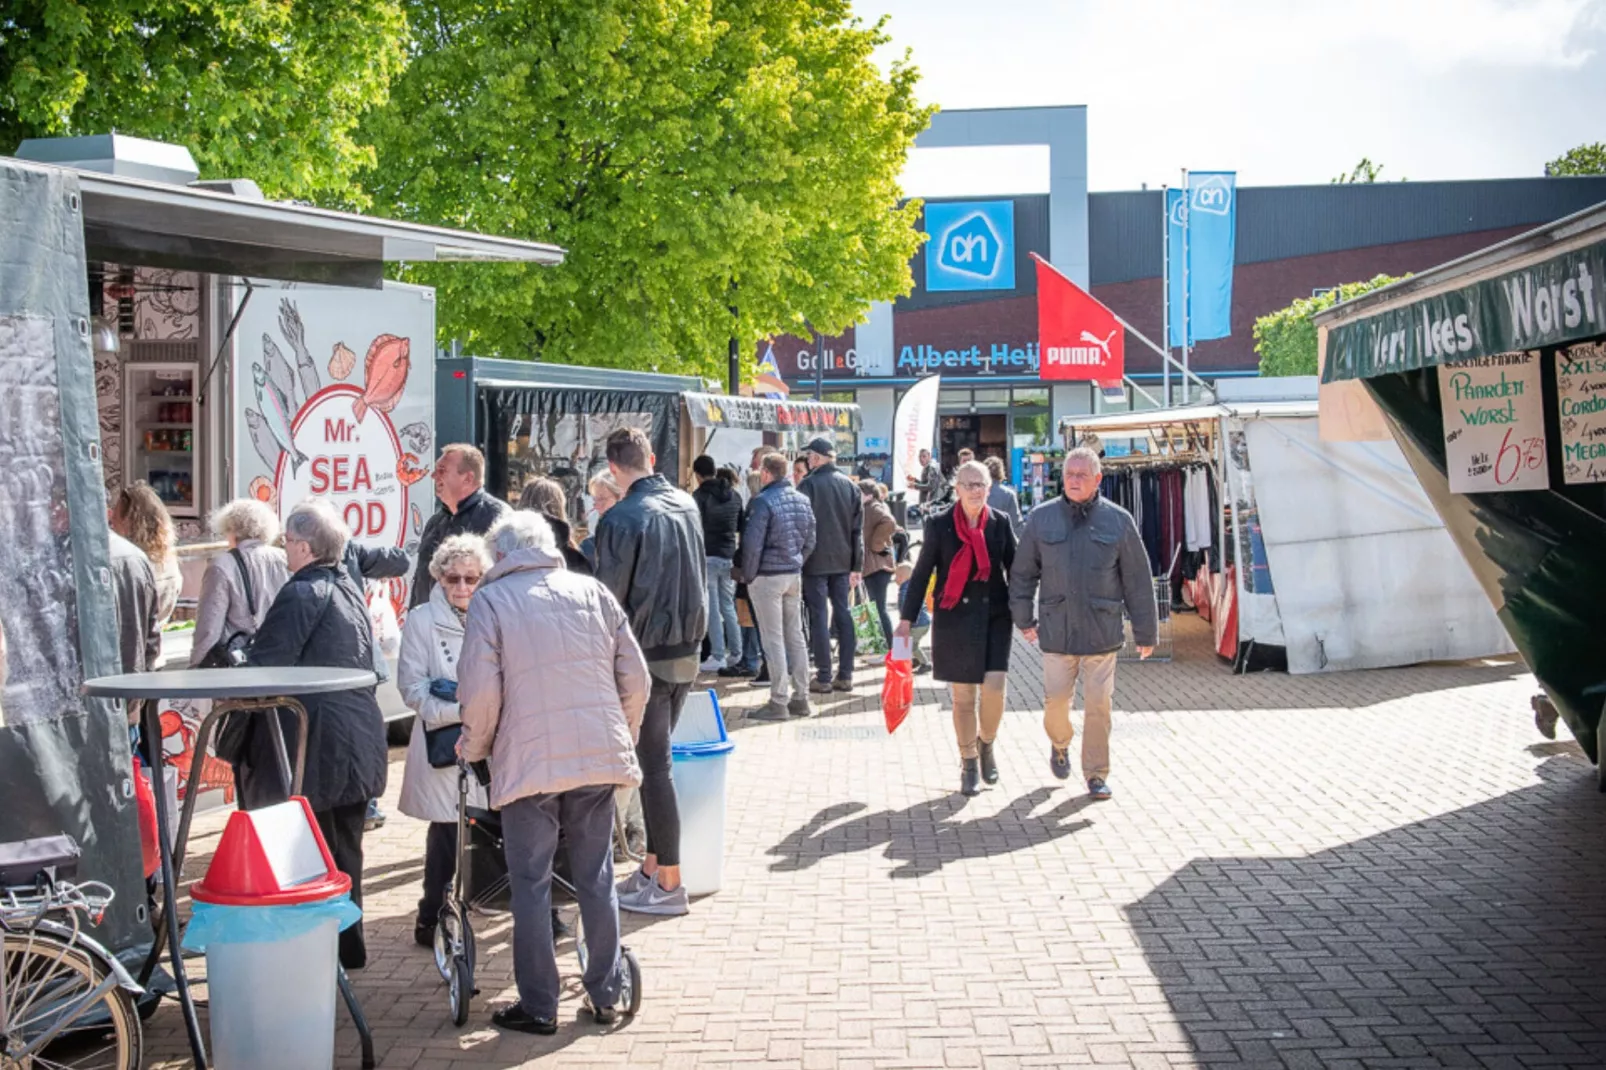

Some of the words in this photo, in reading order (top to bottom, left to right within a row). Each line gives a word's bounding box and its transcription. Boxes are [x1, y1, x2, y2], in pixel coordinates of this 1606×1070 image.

[1503, 262, 1595, 340] Worst
[897, 343, 981, 369] Albert
[1047, 346, 1101, 366] PUMA
[324, 417, 361, 443] Mr.
[309, 456, 373, 494] SEA
[342, 500, 387, 537] OD
